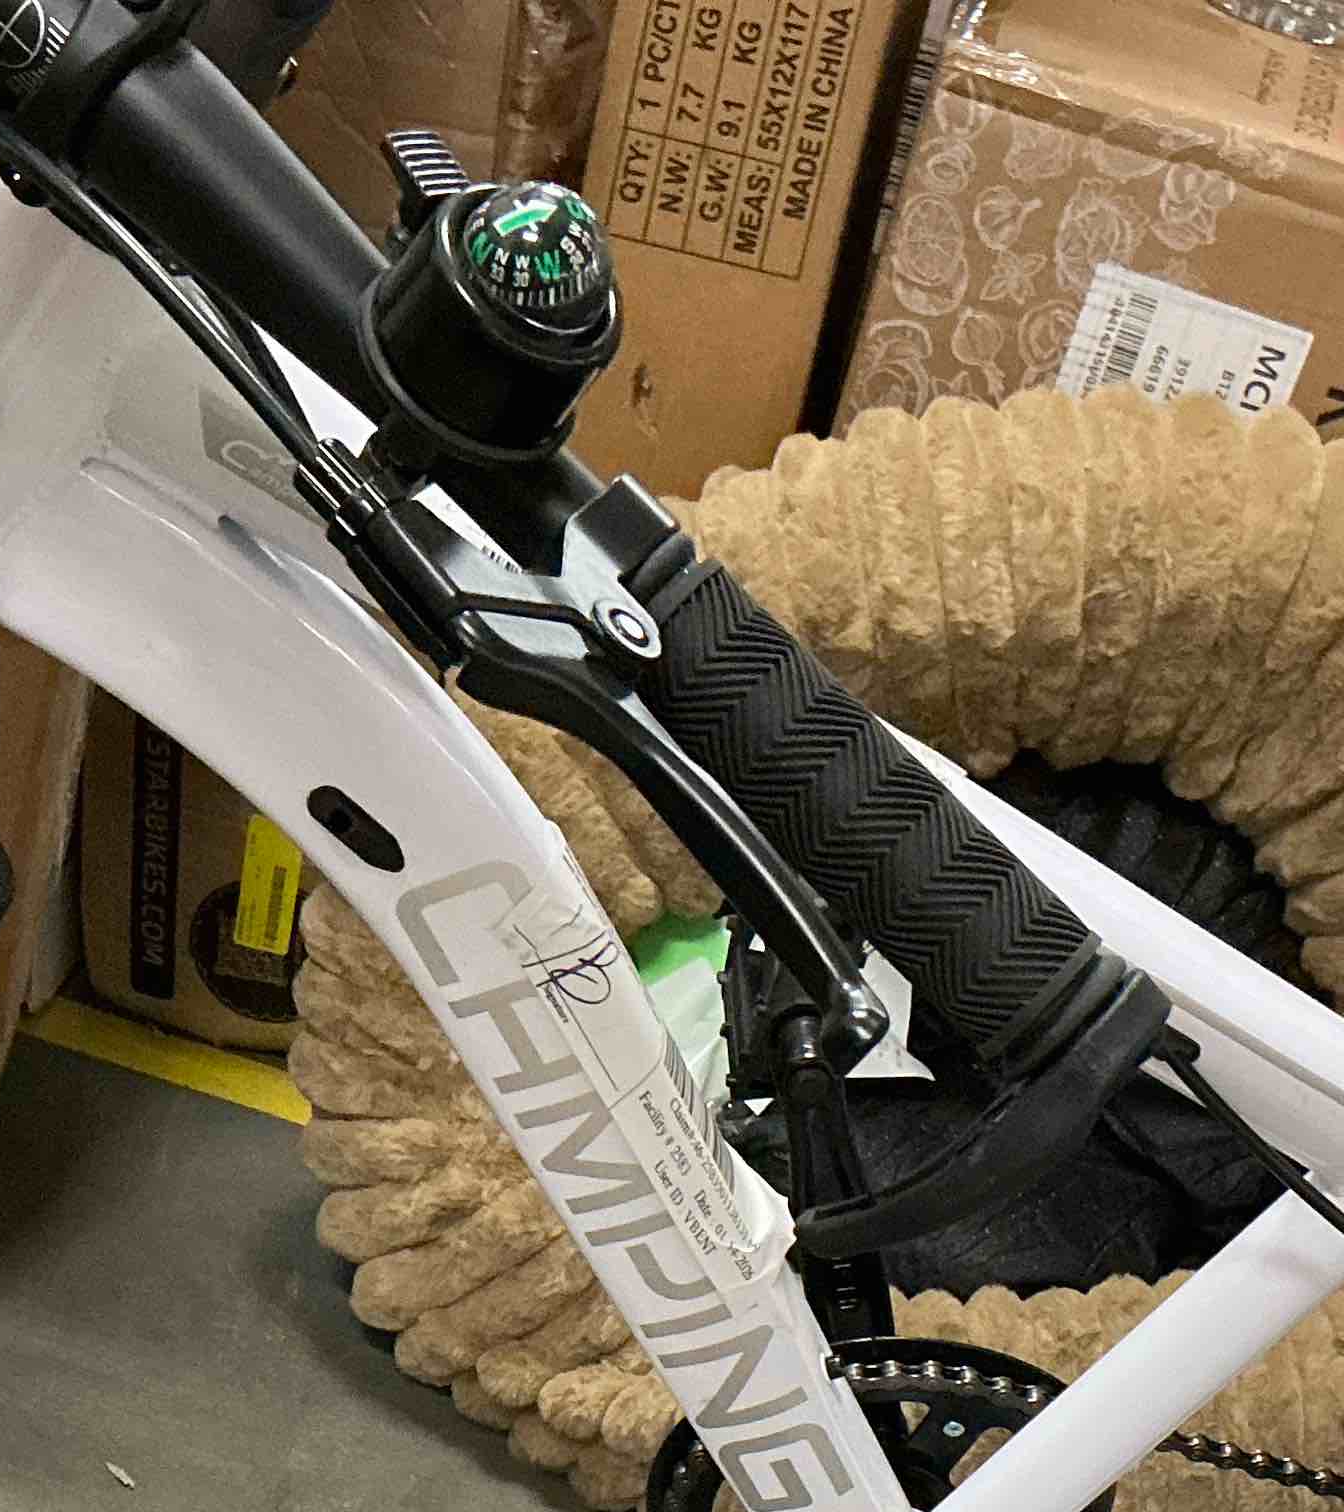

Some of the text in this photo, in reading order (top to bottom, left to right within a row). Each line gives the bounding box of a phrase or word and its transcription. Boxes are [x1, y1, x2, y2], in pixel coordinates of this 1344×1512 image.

[676, 83, 705, 123] 7.7
[692, 8, 722, 51] KG
[717, 99, 746, 138] 9.1
[732, 21, 762, 65] KG
[783, 8, 853, 220] MADE IN CHINA
[619, 139, 654, 203] QTY:
[638, 98, 661, 110] 1
[734, 166, 774, 254] MEAS:
[141, 727, 171, 966] STARBIKES.COM
